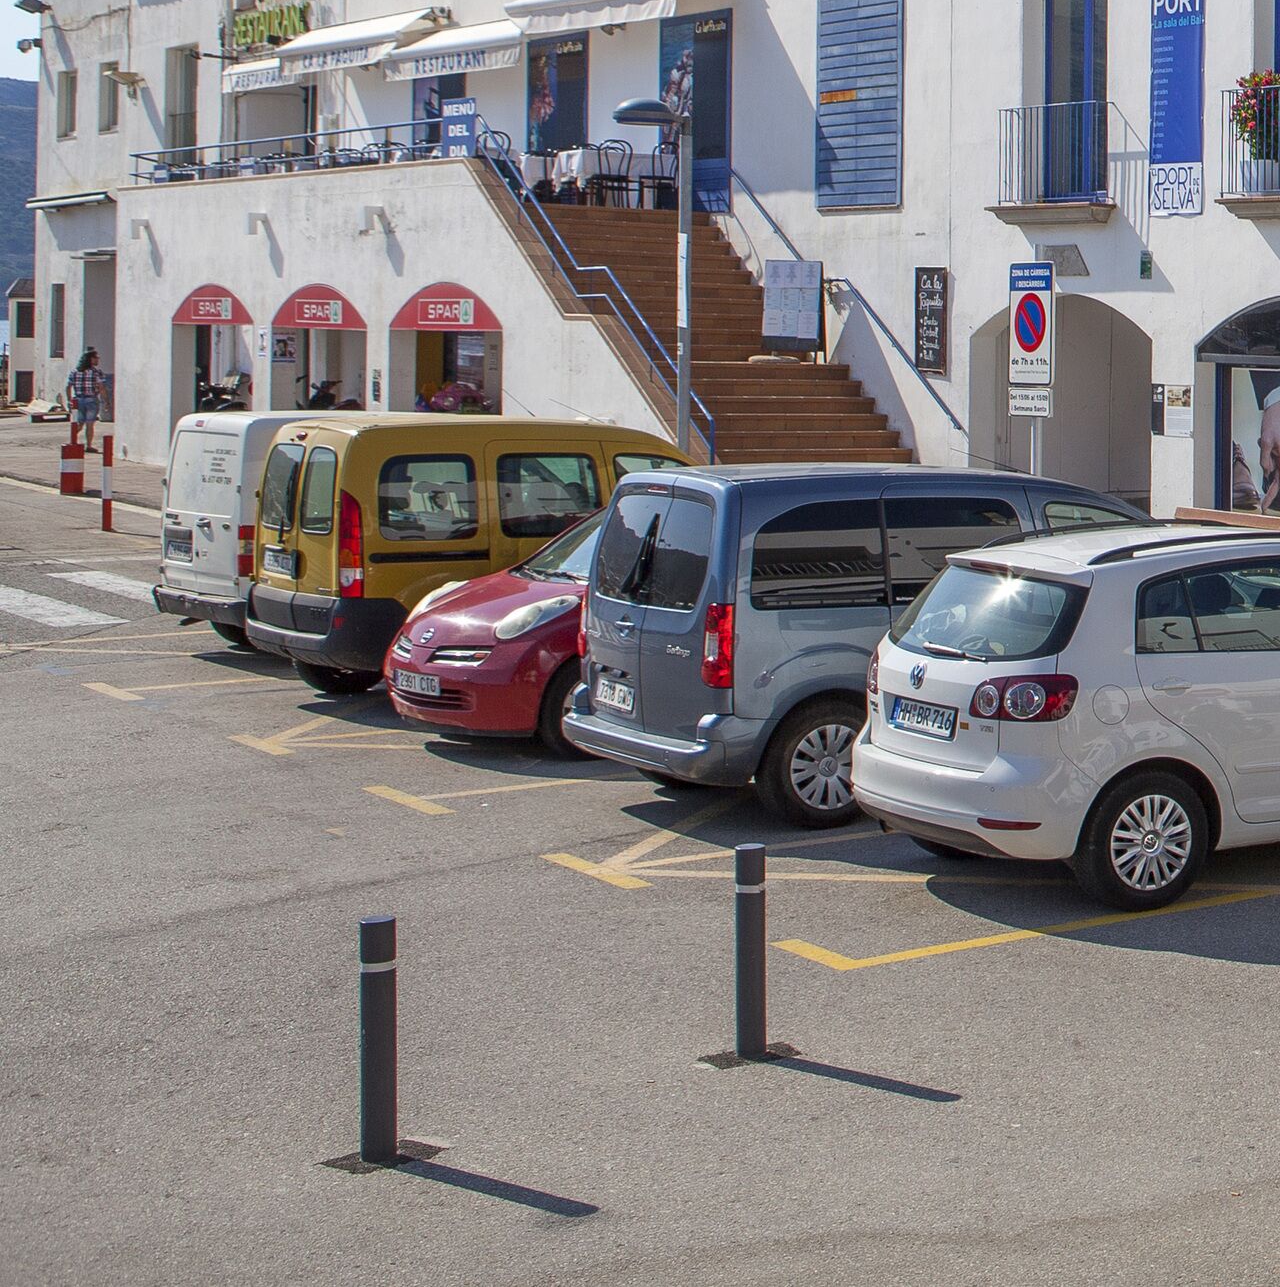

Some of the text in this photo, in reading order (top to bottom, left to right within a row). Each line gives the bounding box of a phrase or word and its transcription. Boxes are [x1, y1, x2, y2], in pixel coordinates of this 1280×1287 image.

[1154, 19, 1162, 29] La
[1163, 17, 1177, 28] sala
[1178, 16, 1189, 27] del
[415, 50, 487, 75] RESTAURANT
[448, 124, 470, 137] DEL
[449, 145, 469, 157] DIA
[1154, 183, 1195, 210] SELVA
[921, 274, 943, 290] Ca la
[198, 302, 222, 315] SPAR
[303, 304, 331, 318] SPAR
[427, 303, 459, 319] SPAR
[420, 676, 436, 693] CTG
[915, 707, 931, 726] BR
[932, 710, 952, 731] 716
